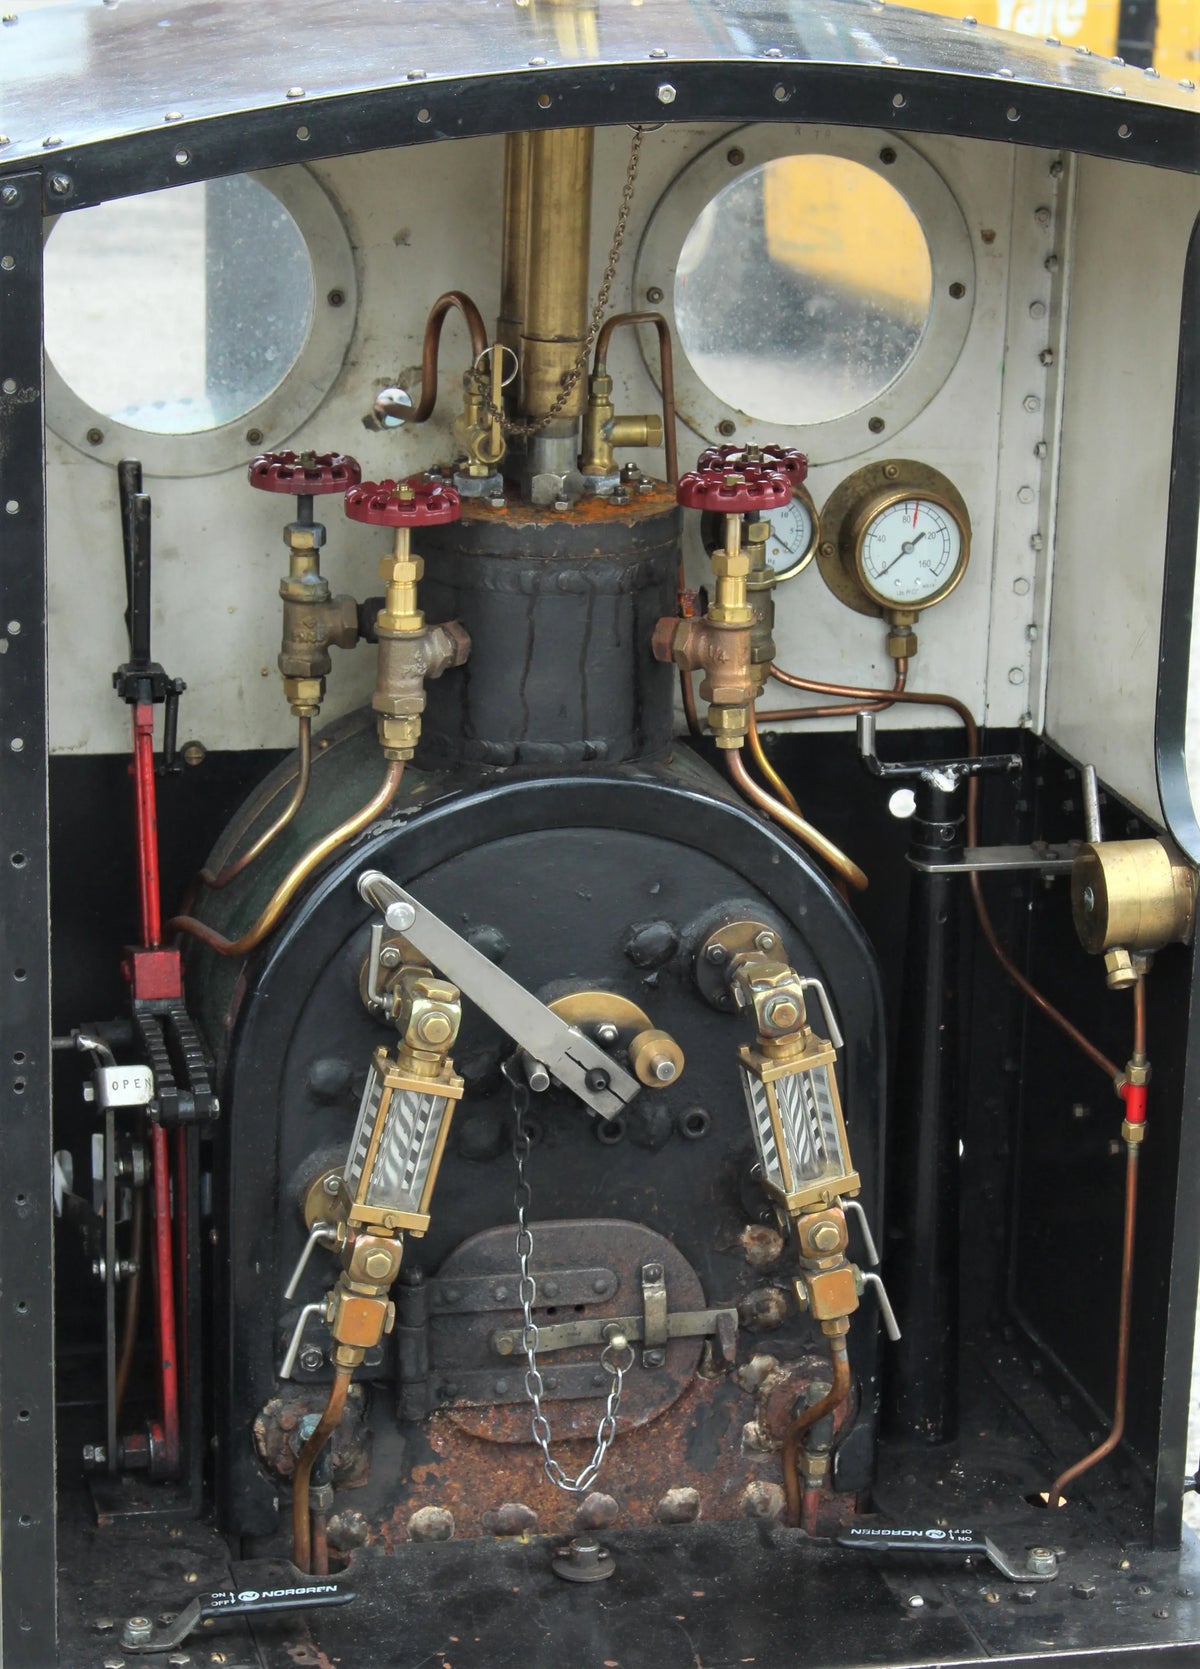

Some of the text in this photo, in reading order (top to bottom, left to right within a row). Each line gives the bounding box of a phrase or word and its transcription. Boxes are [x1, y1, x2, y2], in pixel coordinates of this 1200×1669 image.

[902, 515, 911, 524] 80
[878, 535, 886, 543] 40
[881, 560, 887, 568] 0
[918, 559, 931, 568] 160
[112, 1077, 151, 1091] OPEN
[261, 1585, 338, 1598] NORGREN
